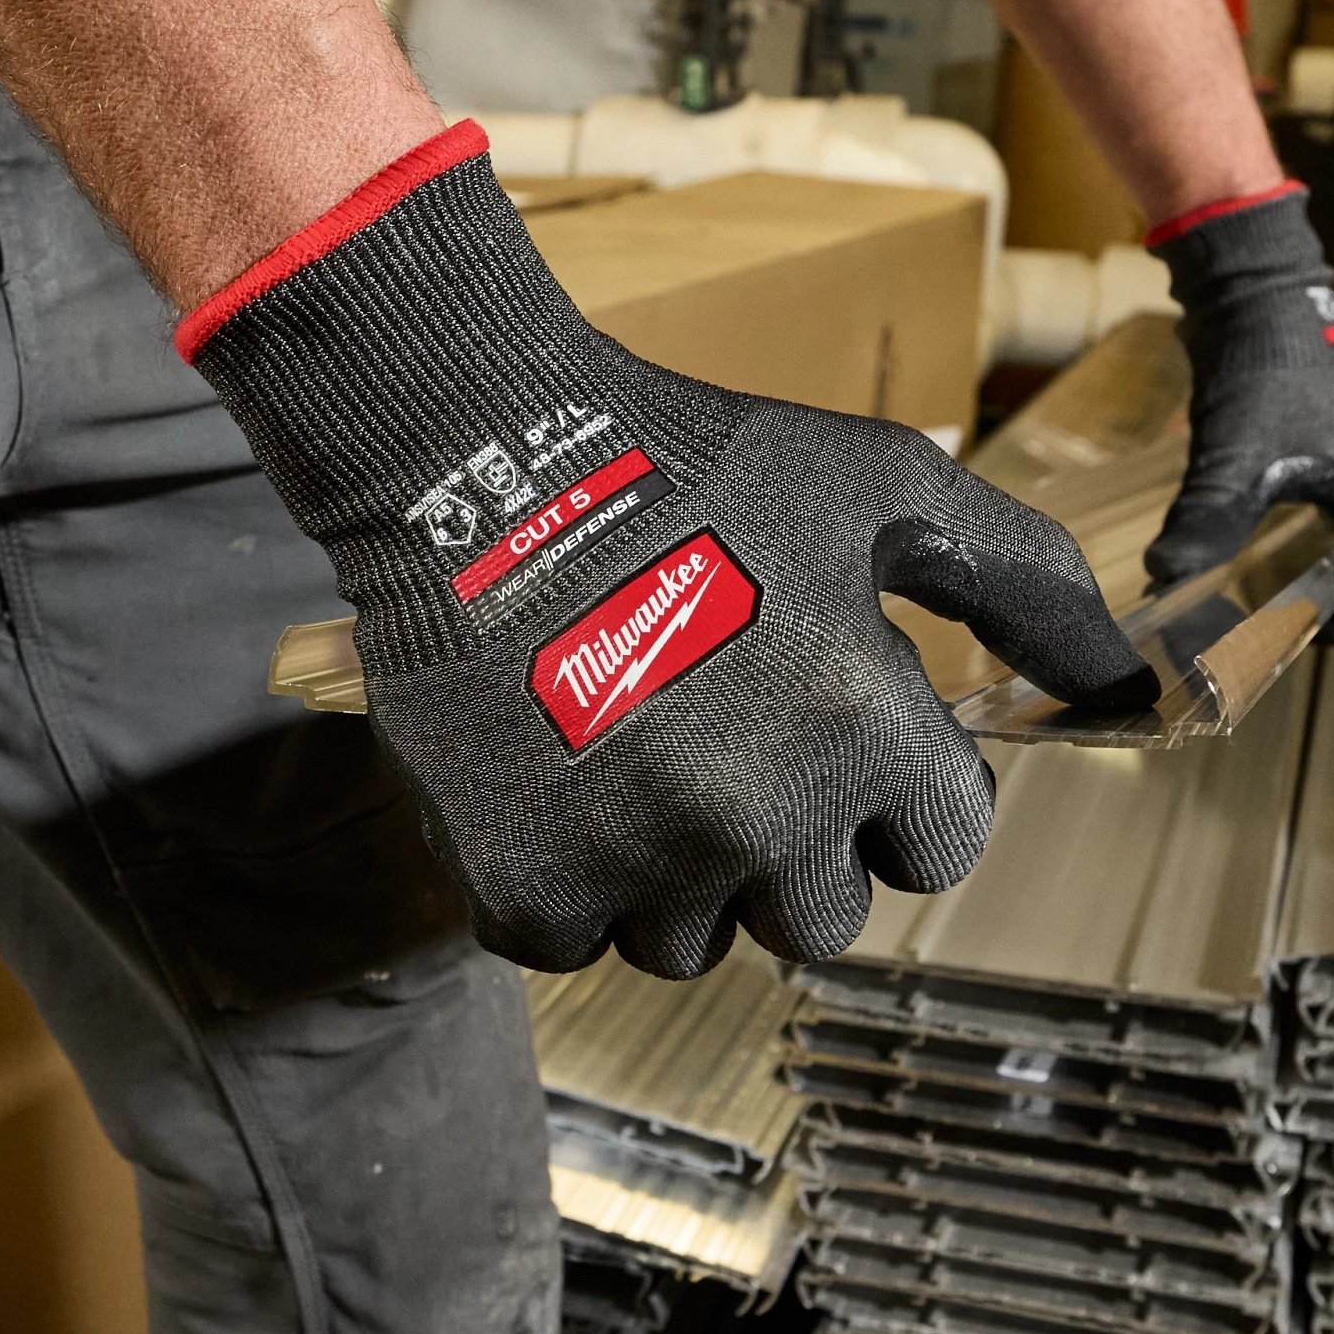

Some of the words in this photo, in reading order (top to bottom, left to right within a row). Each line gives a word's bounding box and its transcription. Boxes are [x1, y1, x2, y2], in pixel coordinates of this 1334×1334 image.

[567, 404, 587, 418] L
[533, 414, 616, 470] 48-73-6952
[466, 442, 499, 472] EN388
[434, 502, 452, 524] A5
[460, 508, 472, 523] 3
[509, 504, 564, 555] CUT
[569, 488, 592, 510] 5
[437, 527, 448, 541] 6
[553, 553, 709, 708] Milwaukee
